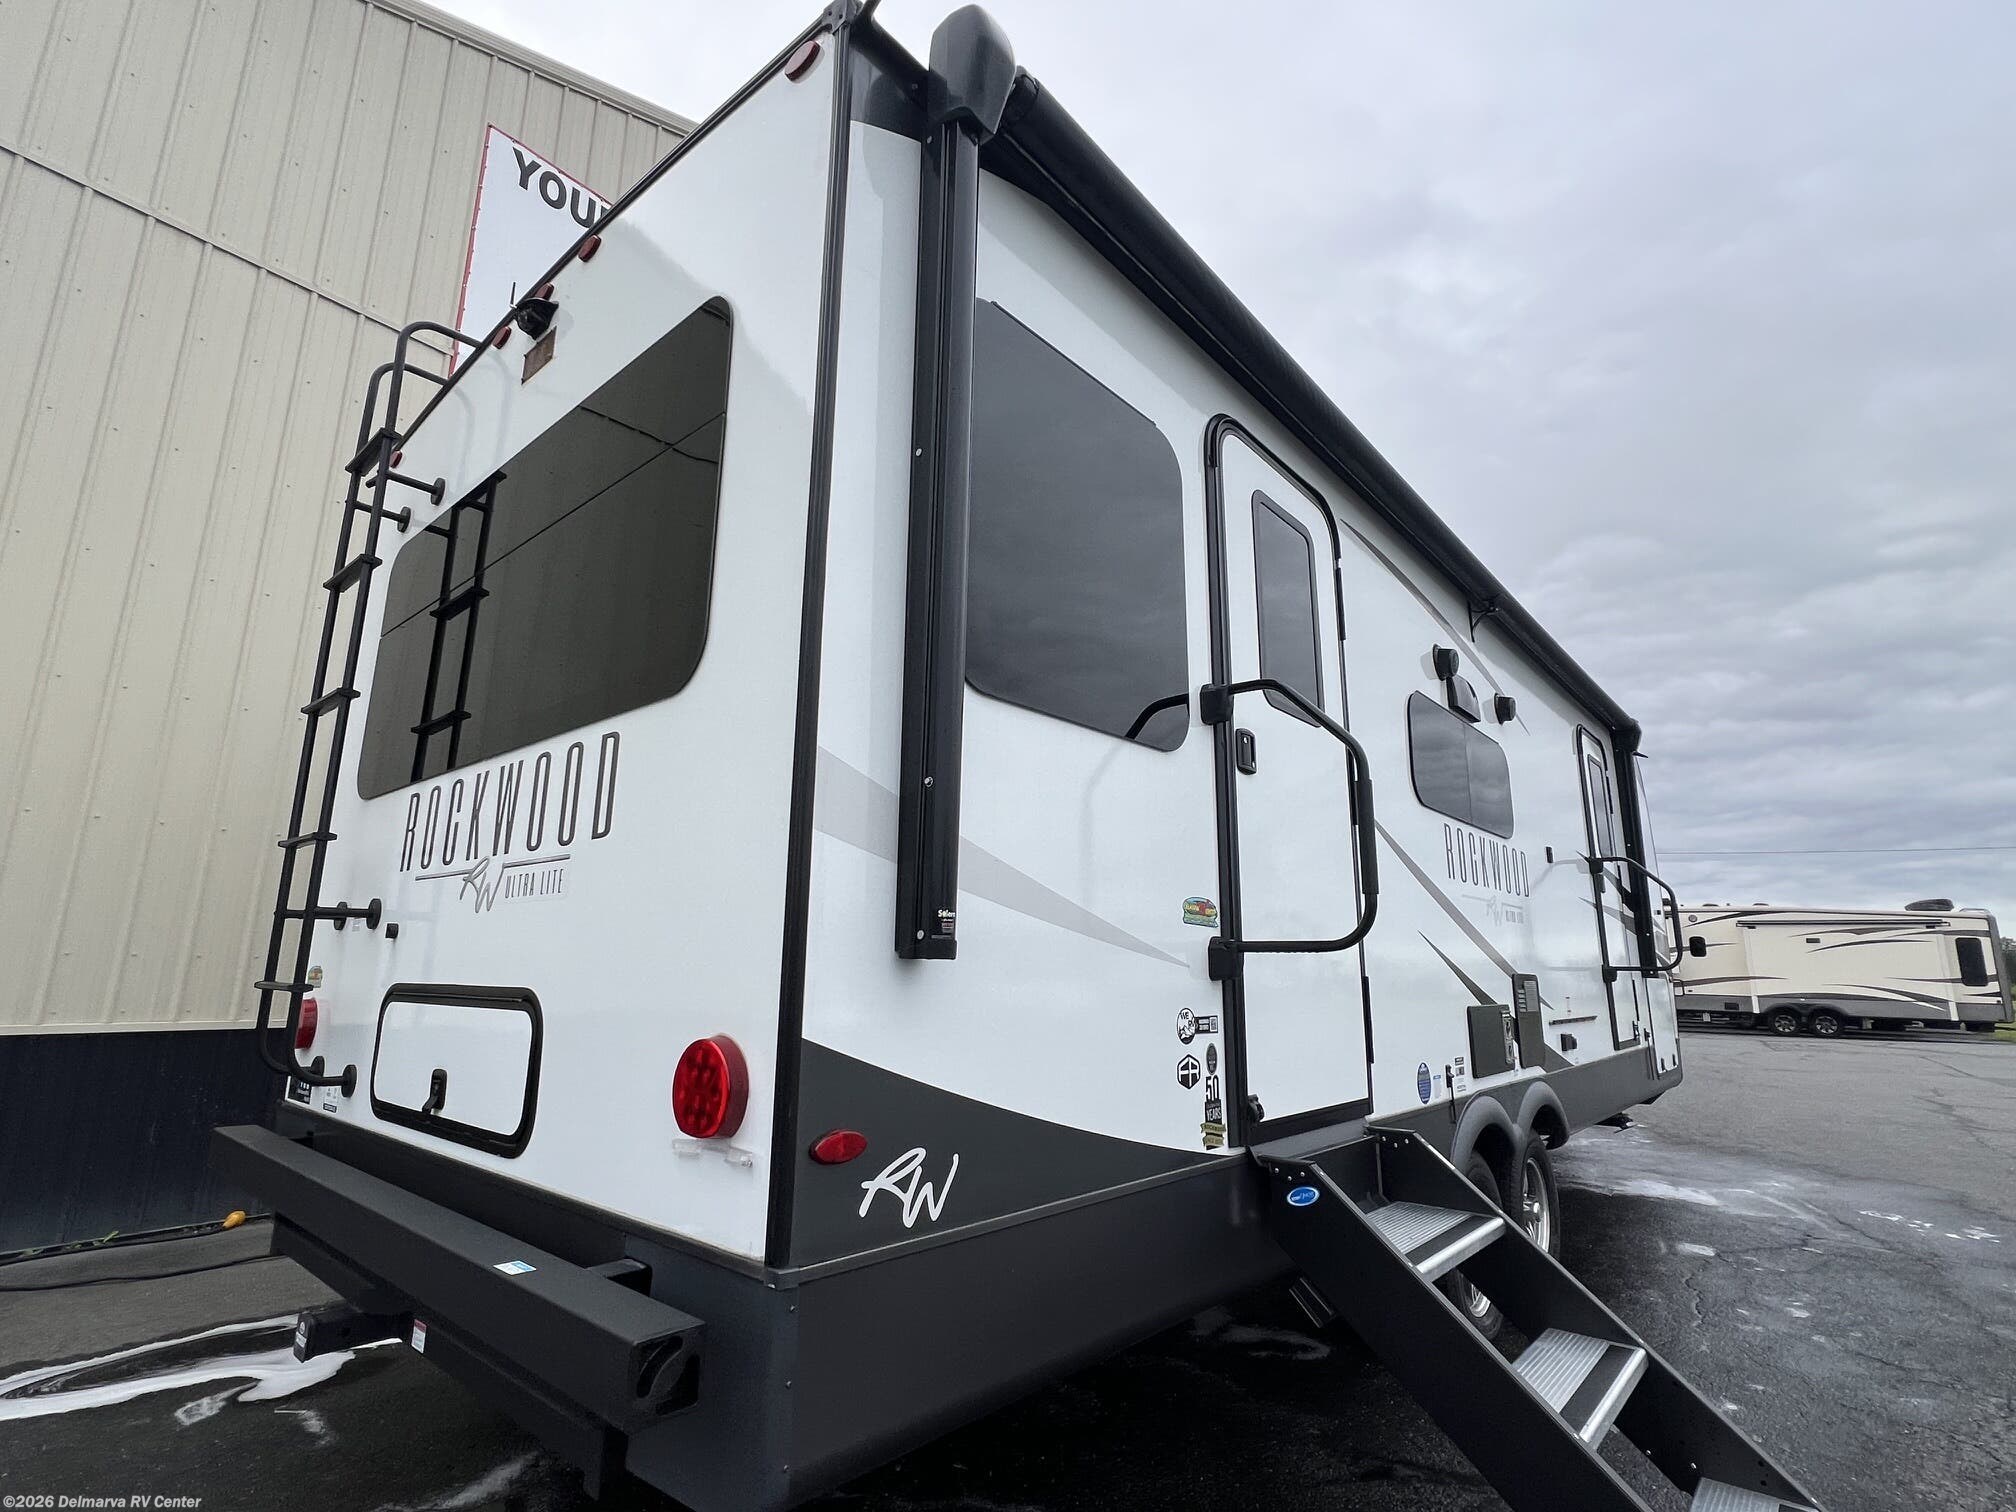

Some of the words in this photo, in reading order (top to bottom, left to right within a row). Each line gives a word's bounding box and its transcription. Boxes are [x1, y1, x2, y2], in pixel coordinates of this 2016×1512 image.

[400, 731, 620, 872] ROCKWOOD
[504, 872, 536, 899] ULTRA
[540, 868, 564, 895] LITE
[1444, 823, 1530, 897] ROCKWOOD
[1206, 1075, 1220, 1100] 50
